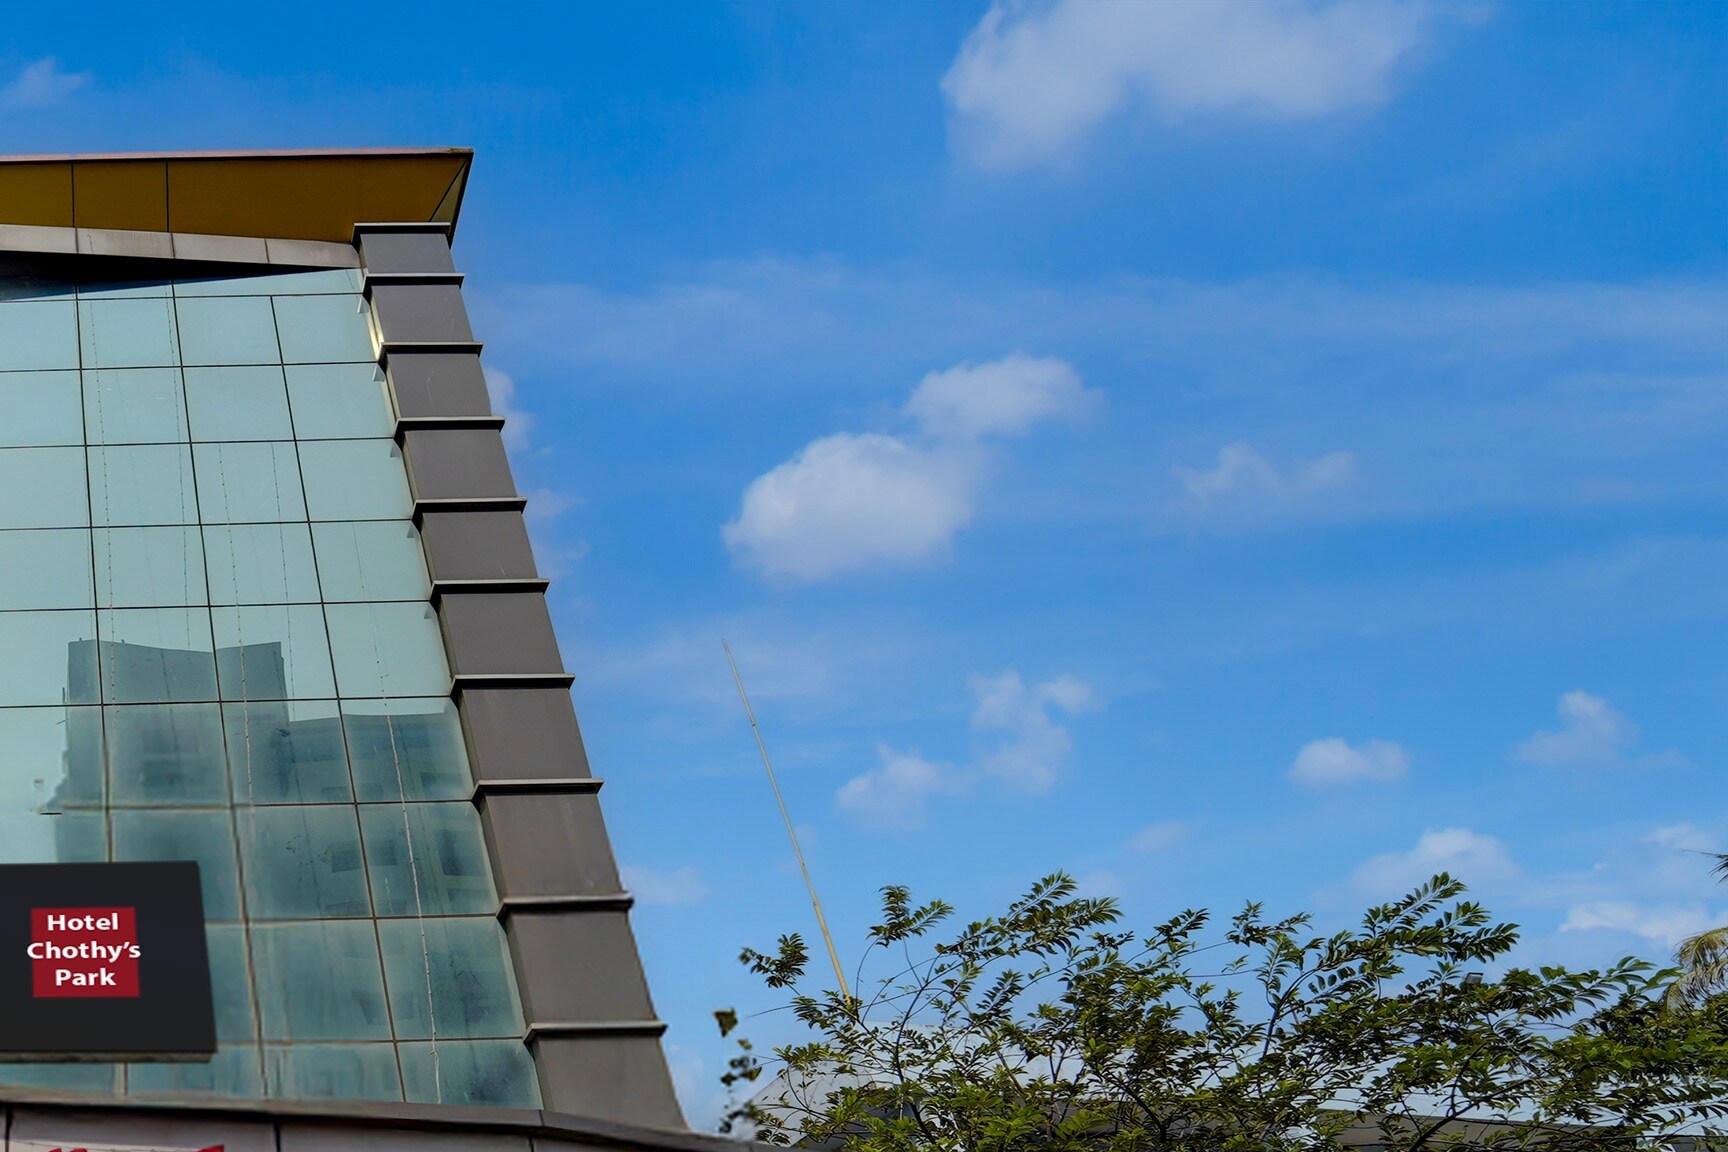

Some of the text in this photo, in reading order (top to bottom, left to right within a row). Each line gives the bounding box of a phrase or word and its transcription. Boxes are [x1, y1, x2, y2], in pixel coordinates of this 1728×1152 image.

[47, 912, 118, 931] Hotel
[27, 940, 141, 962] Chothy's
[55, 967, 116, 987] Park
